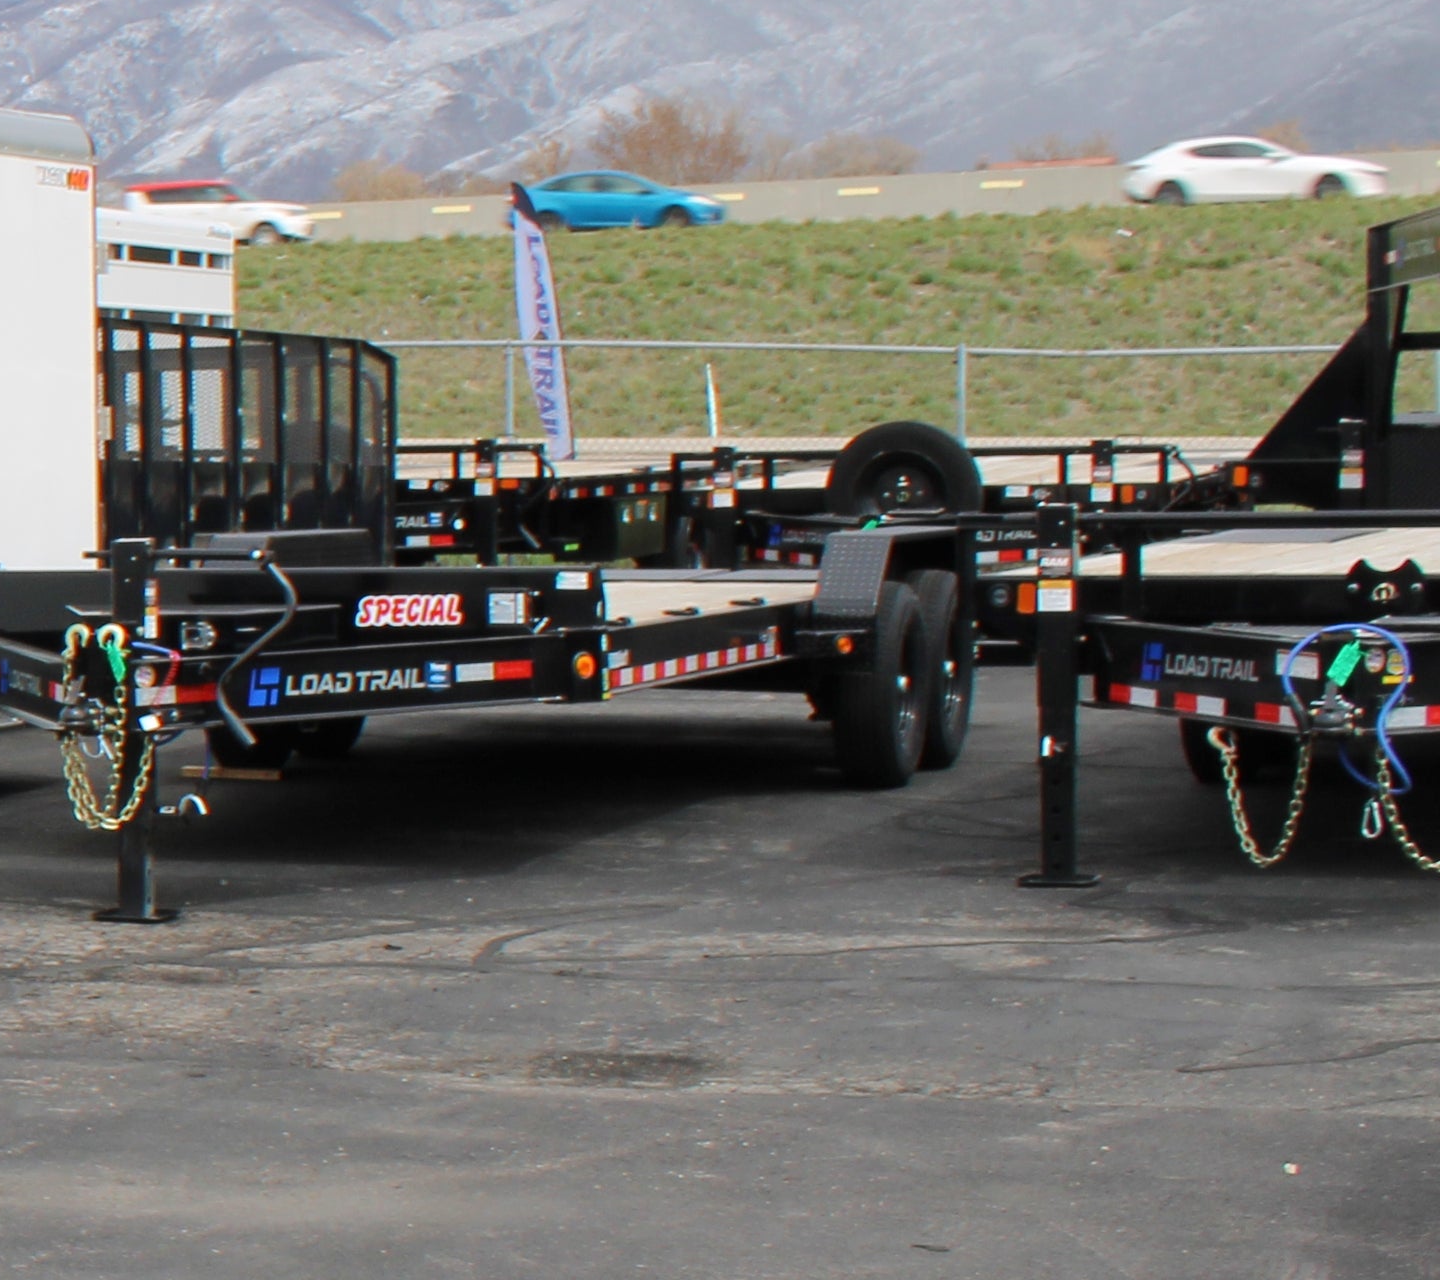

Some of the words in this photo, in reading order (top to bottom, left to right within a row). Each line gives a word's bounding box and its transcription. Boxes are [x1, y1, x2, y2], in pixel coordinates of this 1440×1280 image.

[356, 595, 462, 626] SPECIAL
[285, 672, 354, 696] LOAD
[355, 668, 426, 692] TRAIL
[1165, 653, 1209, 677] LOAD
[1210, 656, 1260, 682] TRAIL
